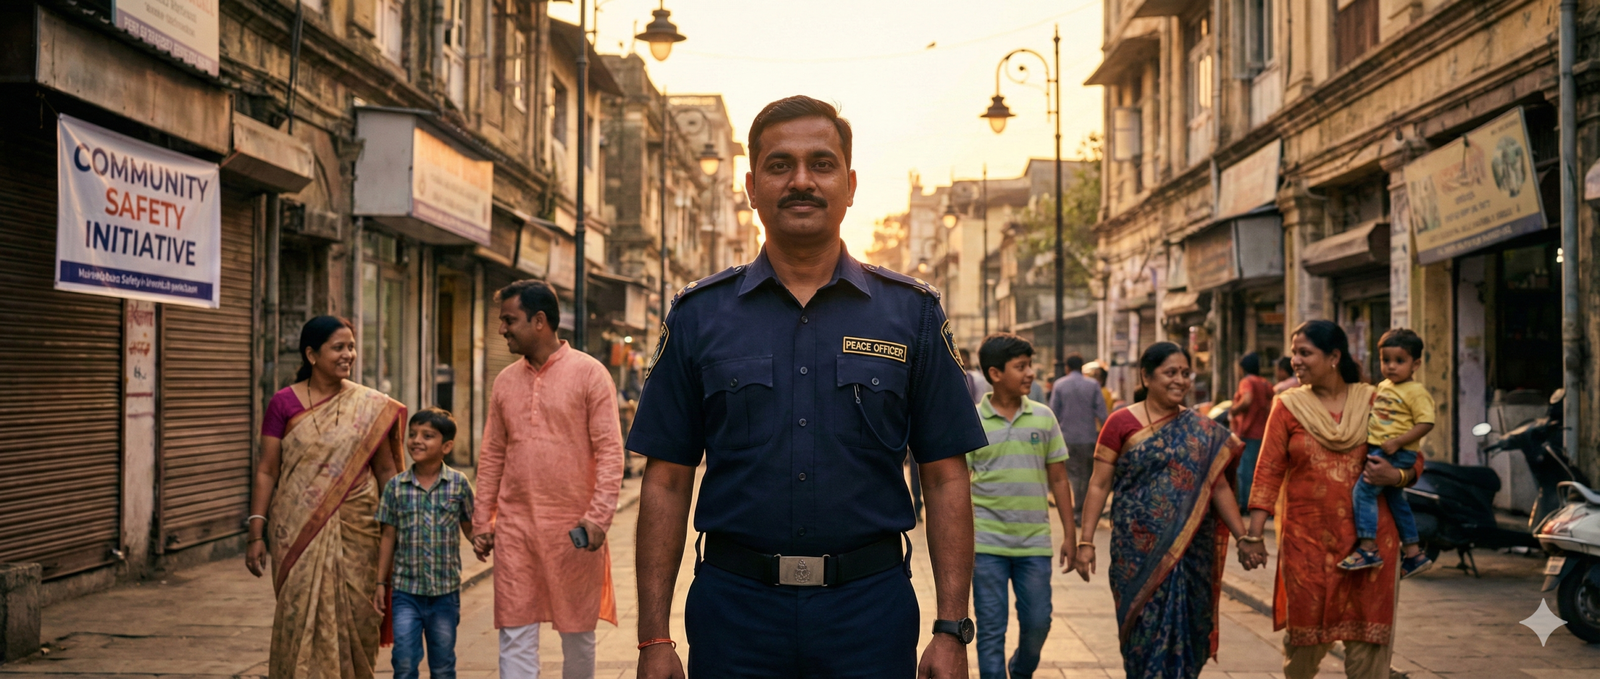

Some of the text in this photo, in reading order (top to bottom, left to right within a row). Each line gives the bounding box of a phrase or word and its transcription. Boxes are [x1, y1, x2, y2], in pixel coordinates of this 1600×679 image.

[74, 143, 208, 202] COMMUNITY
[105, 187, 185, 230] SAFETY
[86, 220, 196, 266] INITIATIVE
[846, 340, 904, 358] PEACE OFFICER
